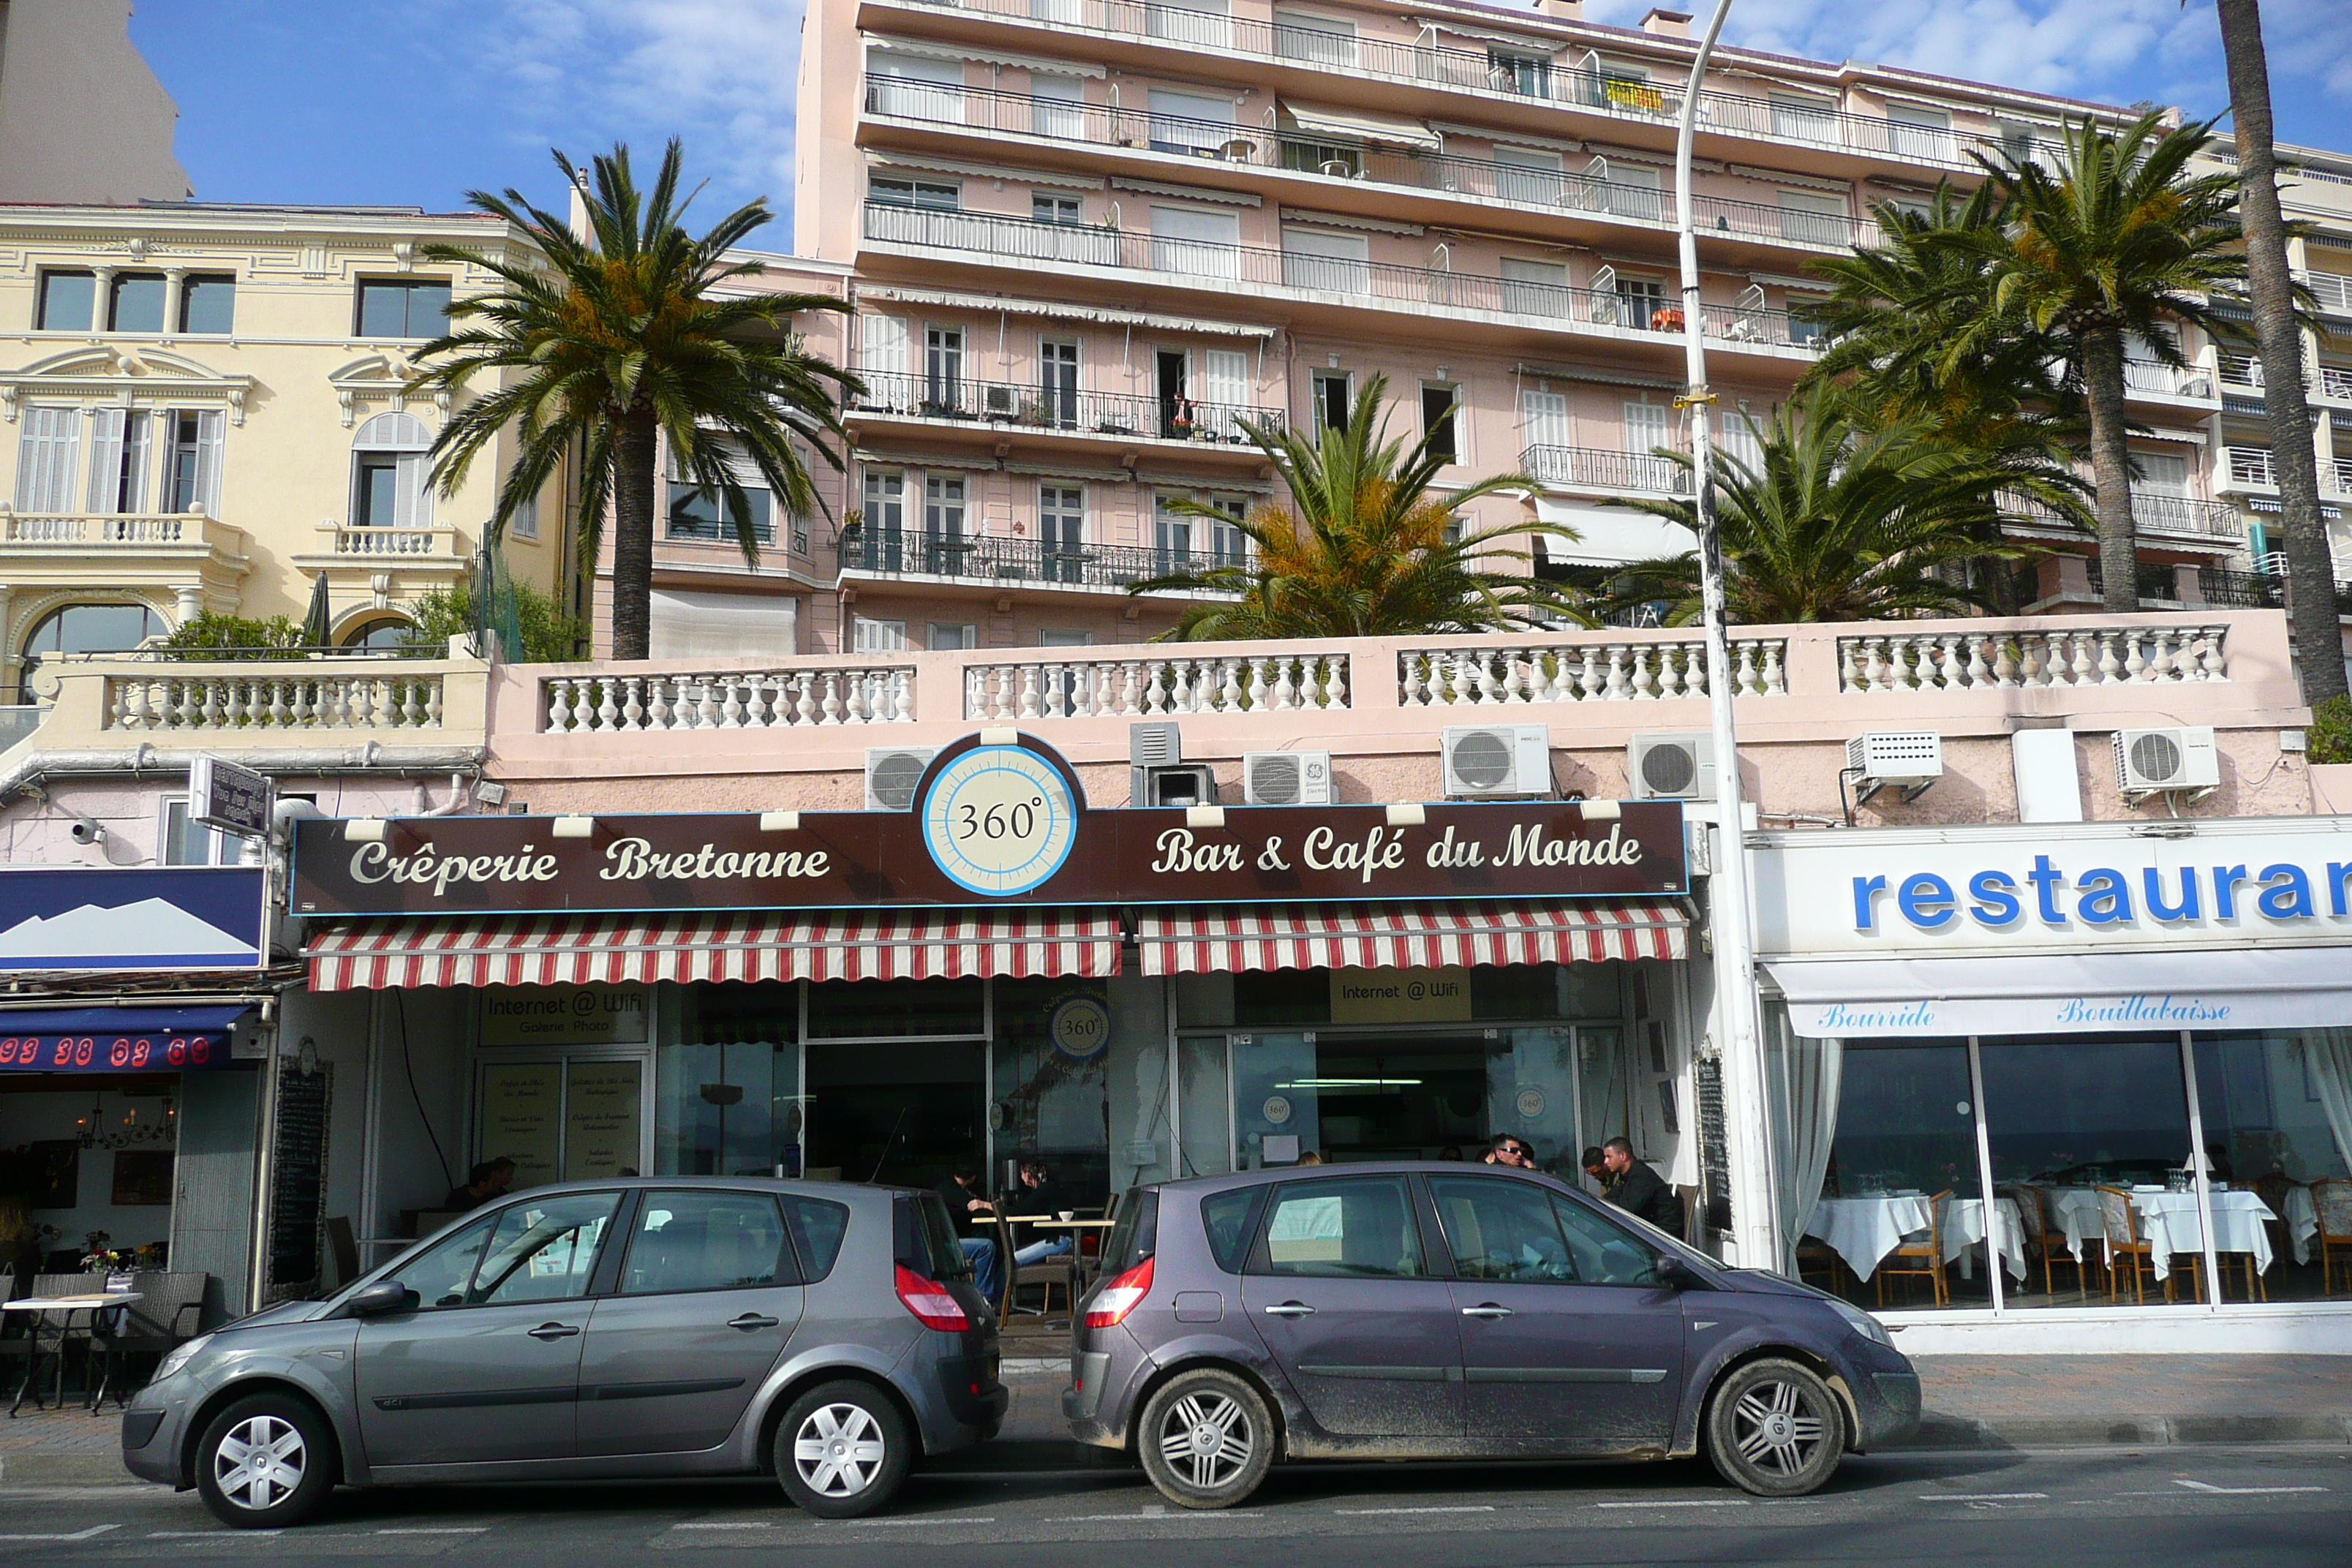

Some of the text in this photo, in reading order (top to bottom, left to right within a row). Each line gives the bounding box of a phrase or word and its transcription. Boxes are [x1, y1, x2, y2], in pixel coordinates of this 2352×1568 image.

[958, 796, 1043, 840] 360°
[1151, 822, 1643, 883] Bar & Café du Monde
[350, 837, 831, 897] Crêperie Bretonne
[488, 990, 642, 1017] Internet @ Wifi
[1342, 981, 1460, 1000] Internet @ Wifi
[1817, 1000, 1935, 1028] Bourride
[2057, 995, 2231, 1023] Bouillabaisse
[519, 1020, 609, 1033] Galerie Photo
[1064, 1017, 1098, 1035] 360°
[0, 1036, 210, 1067] 93 38 63 69
